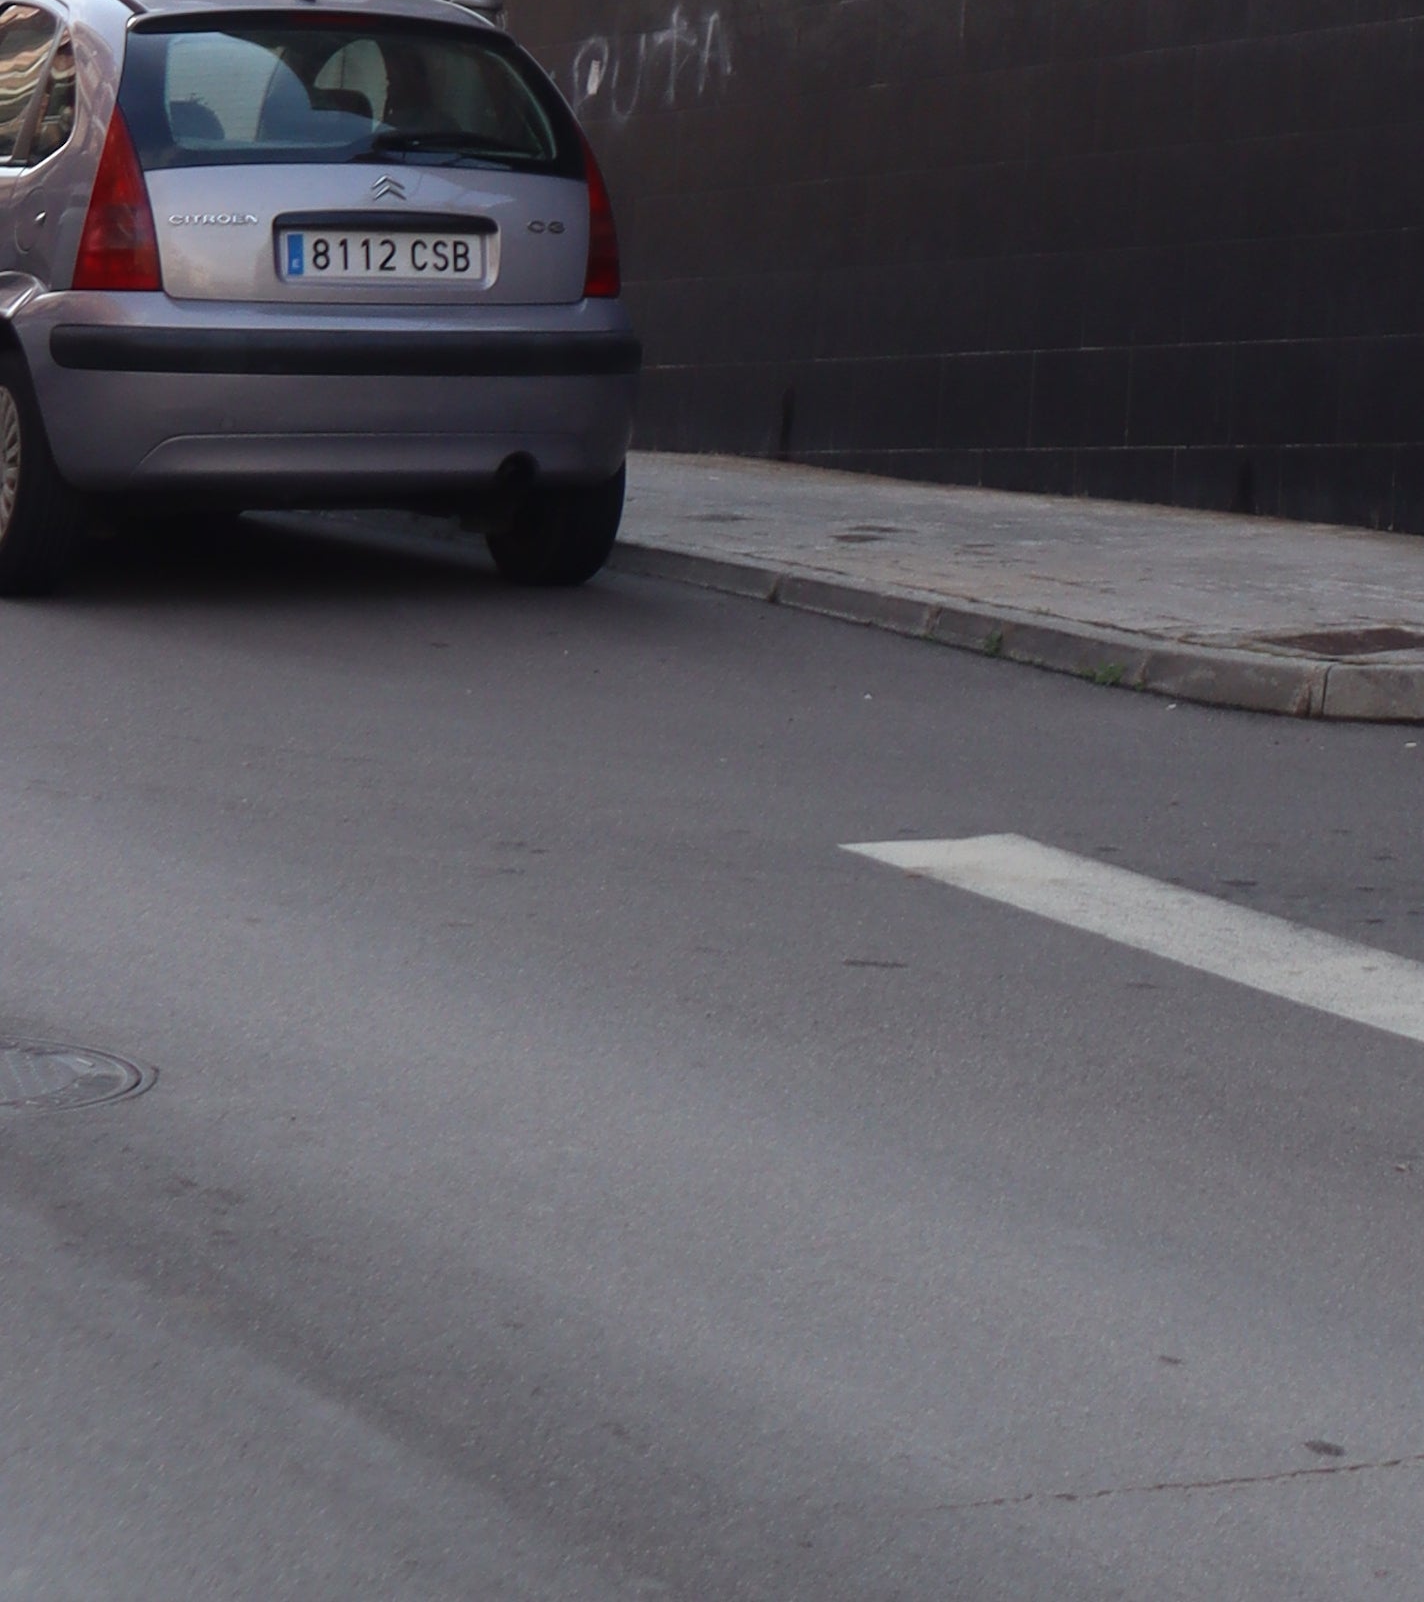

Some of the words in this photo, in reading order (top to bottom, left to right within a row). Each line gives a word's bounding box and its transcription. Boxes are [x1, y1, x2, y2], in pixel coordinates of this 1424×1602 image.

[572, 2, 733, 126] PUTA
[312, 238, 397, 271] 8112
[411, 239, 471, 272] CSB
